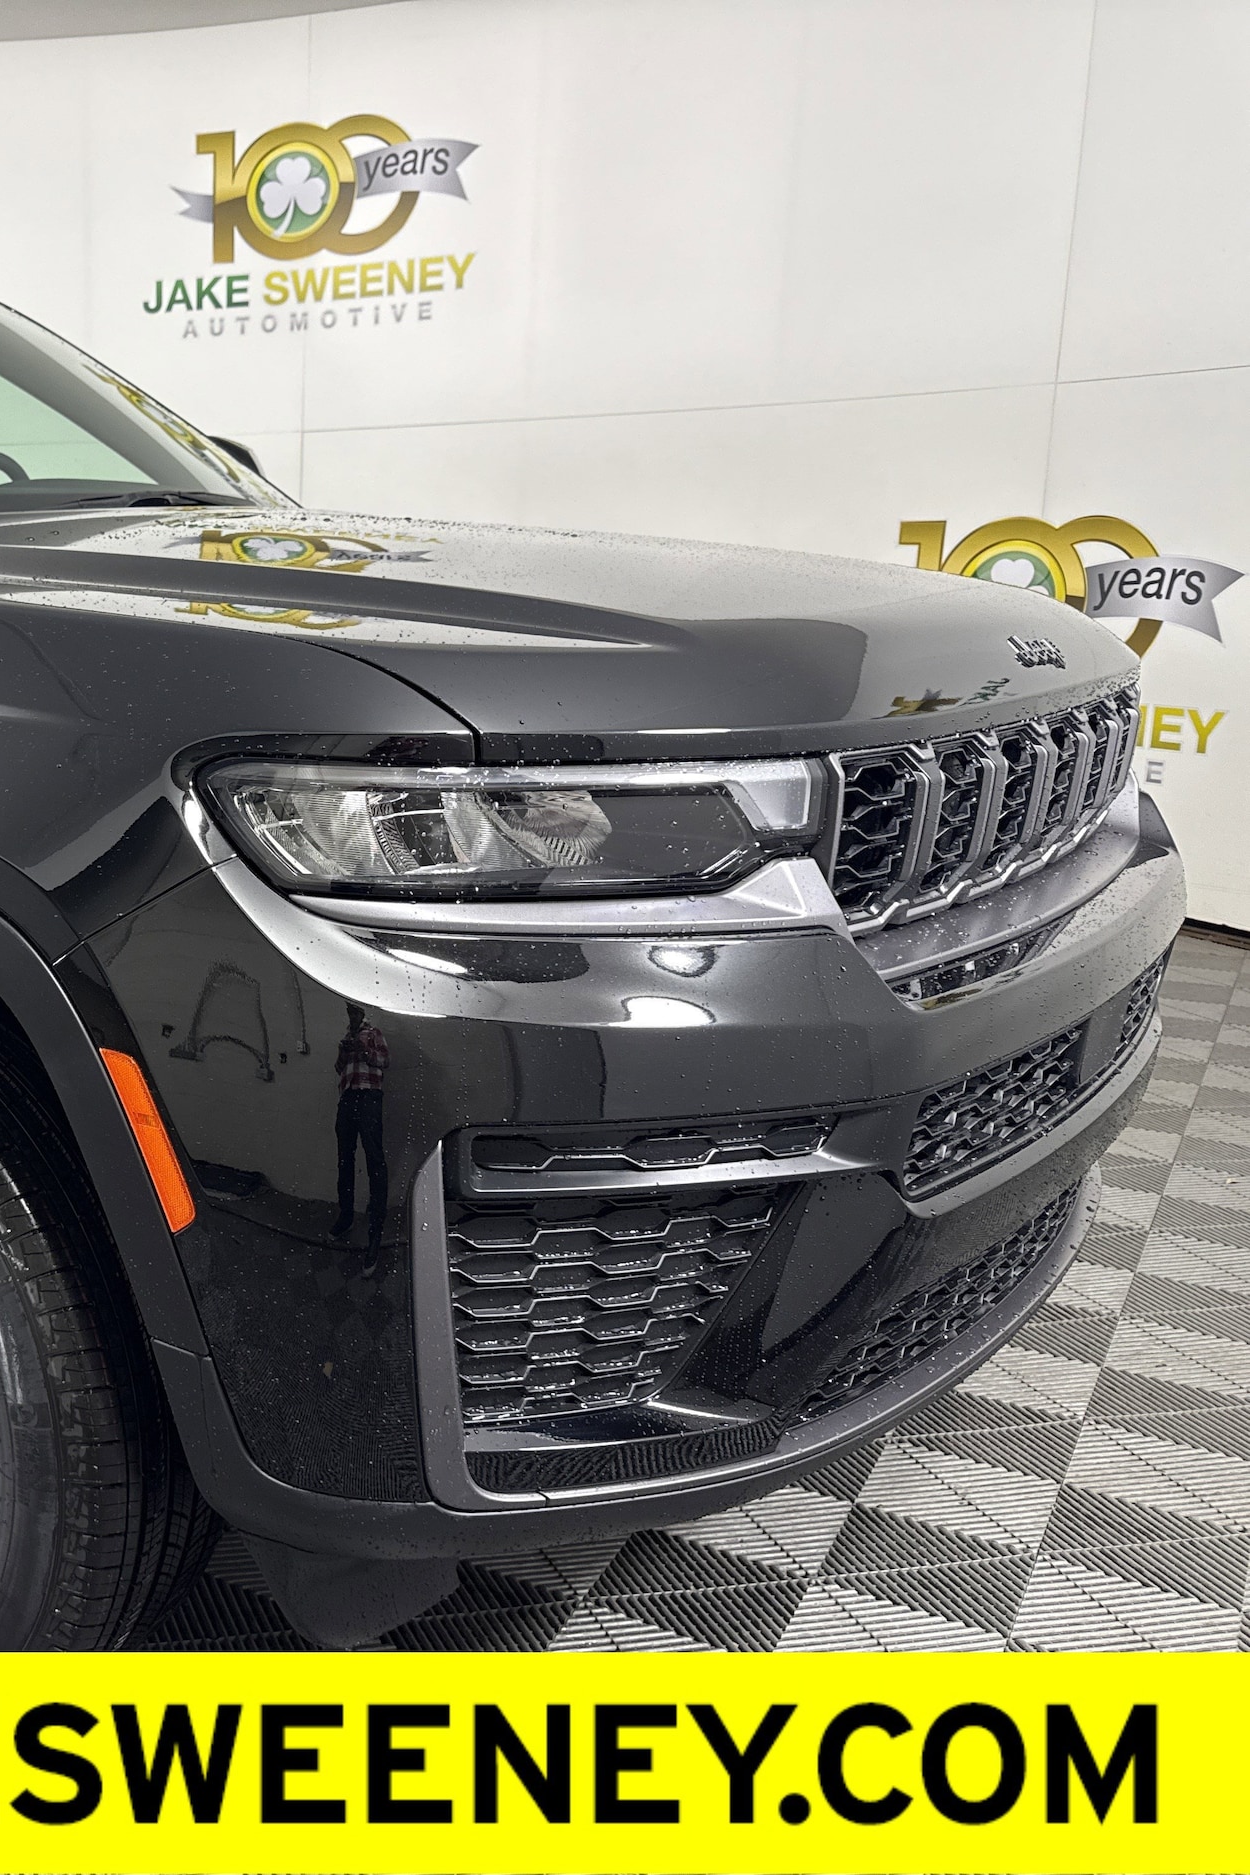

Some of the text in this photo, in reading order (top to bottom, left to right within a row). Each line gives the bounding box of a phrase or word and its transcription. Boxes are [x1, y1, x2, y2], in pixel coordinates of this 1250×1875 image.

[196, 114, 450, 264] 100 years
[143, 252, 476, 313] JAKE SWEENEY
[183, 301, 433, 339] AUTOMOTIVE
[1094, 566, 1206, 610] years
